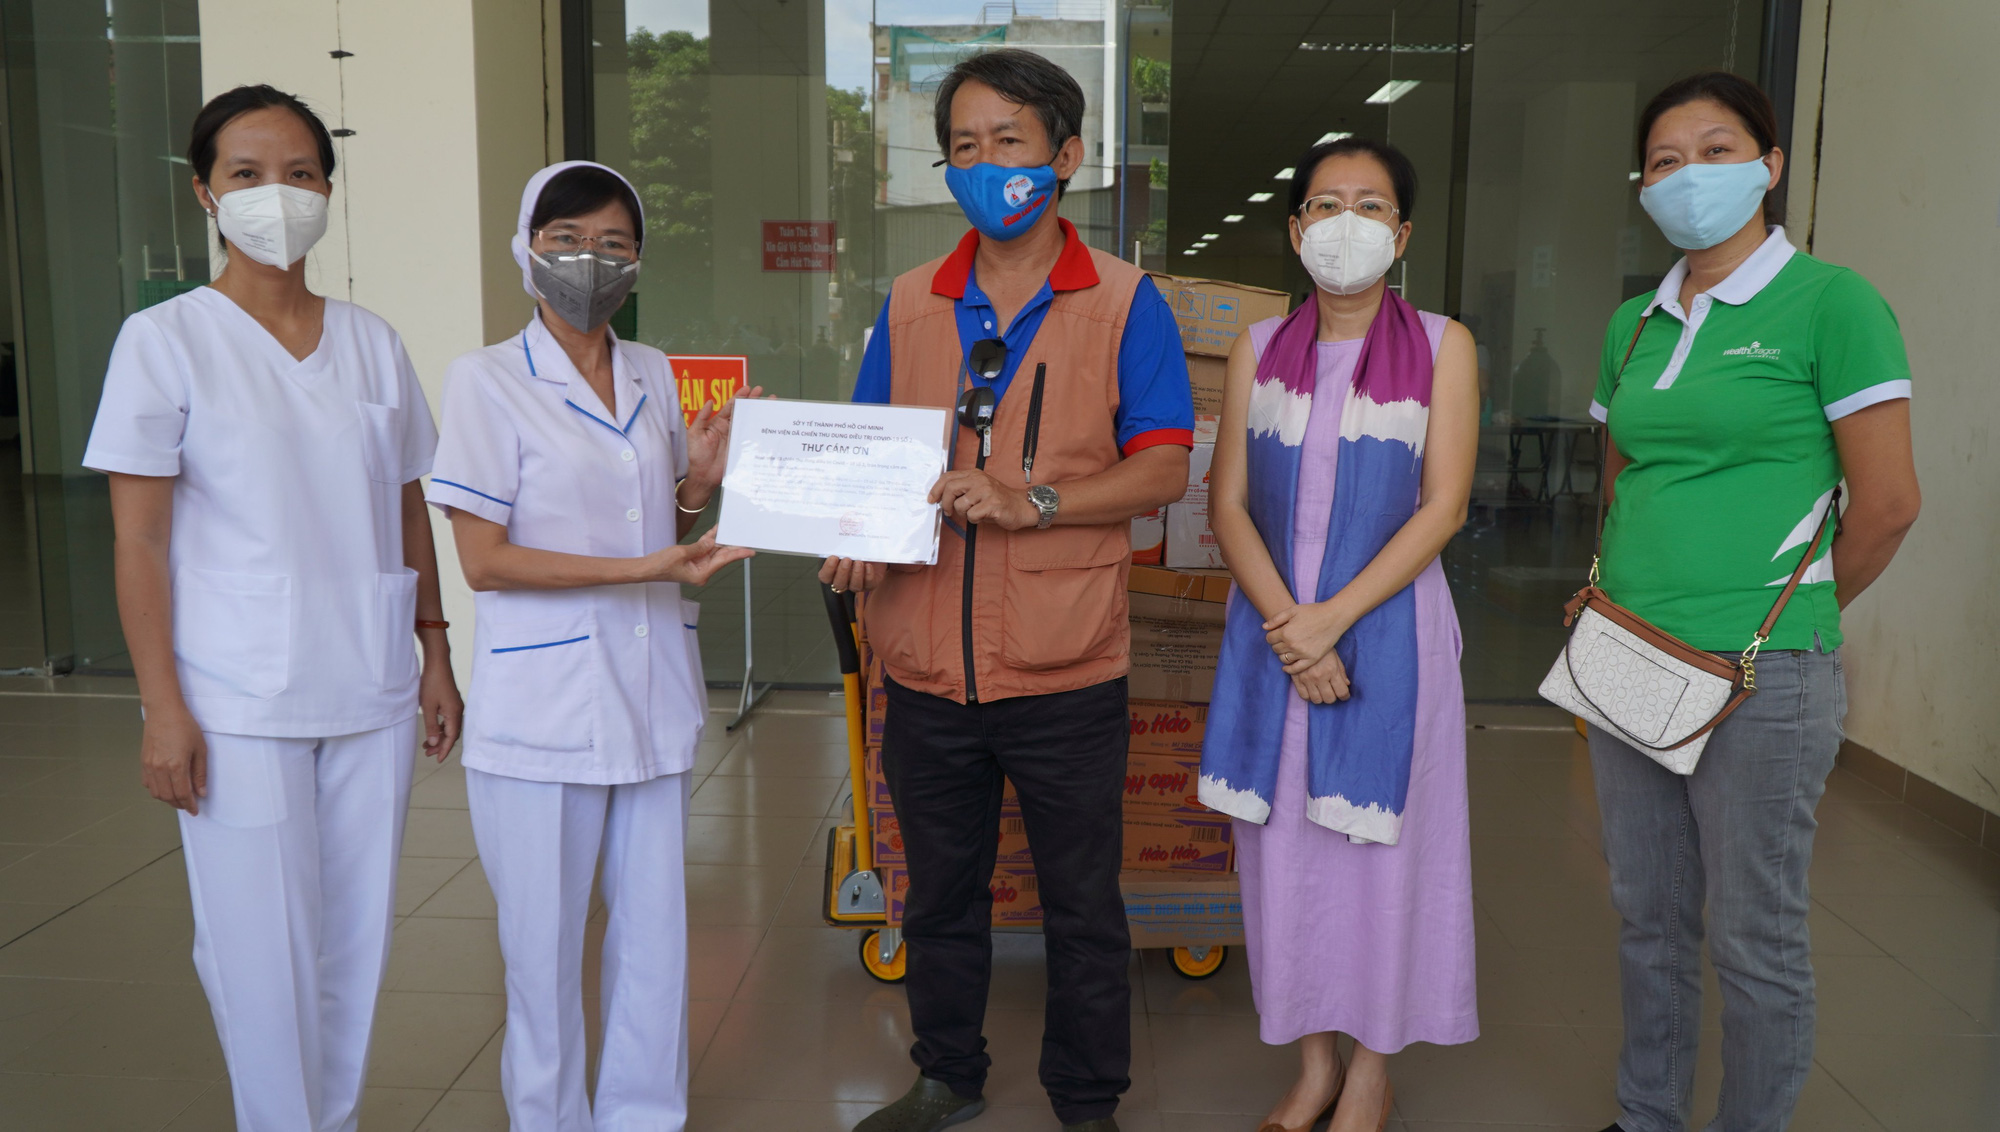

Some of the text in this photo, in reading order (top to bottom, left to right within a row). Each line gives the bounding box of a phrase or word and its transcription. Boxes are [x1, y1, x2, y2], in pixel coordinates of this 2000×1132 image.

[798, 241, 812, 252] Sinh
[675, 369, 704, 411] ÂN
[802, 443, 824, 452] THƯ
[852, 446, 869, 456] ƠN
[1130, 710, 1191, 735] ảo Hảo
[1147, 772, 1189, 796] Hảo
[1139, 843, 1201, 862] Hảo Hảo
[991, 880, 1018, 903] ảo
